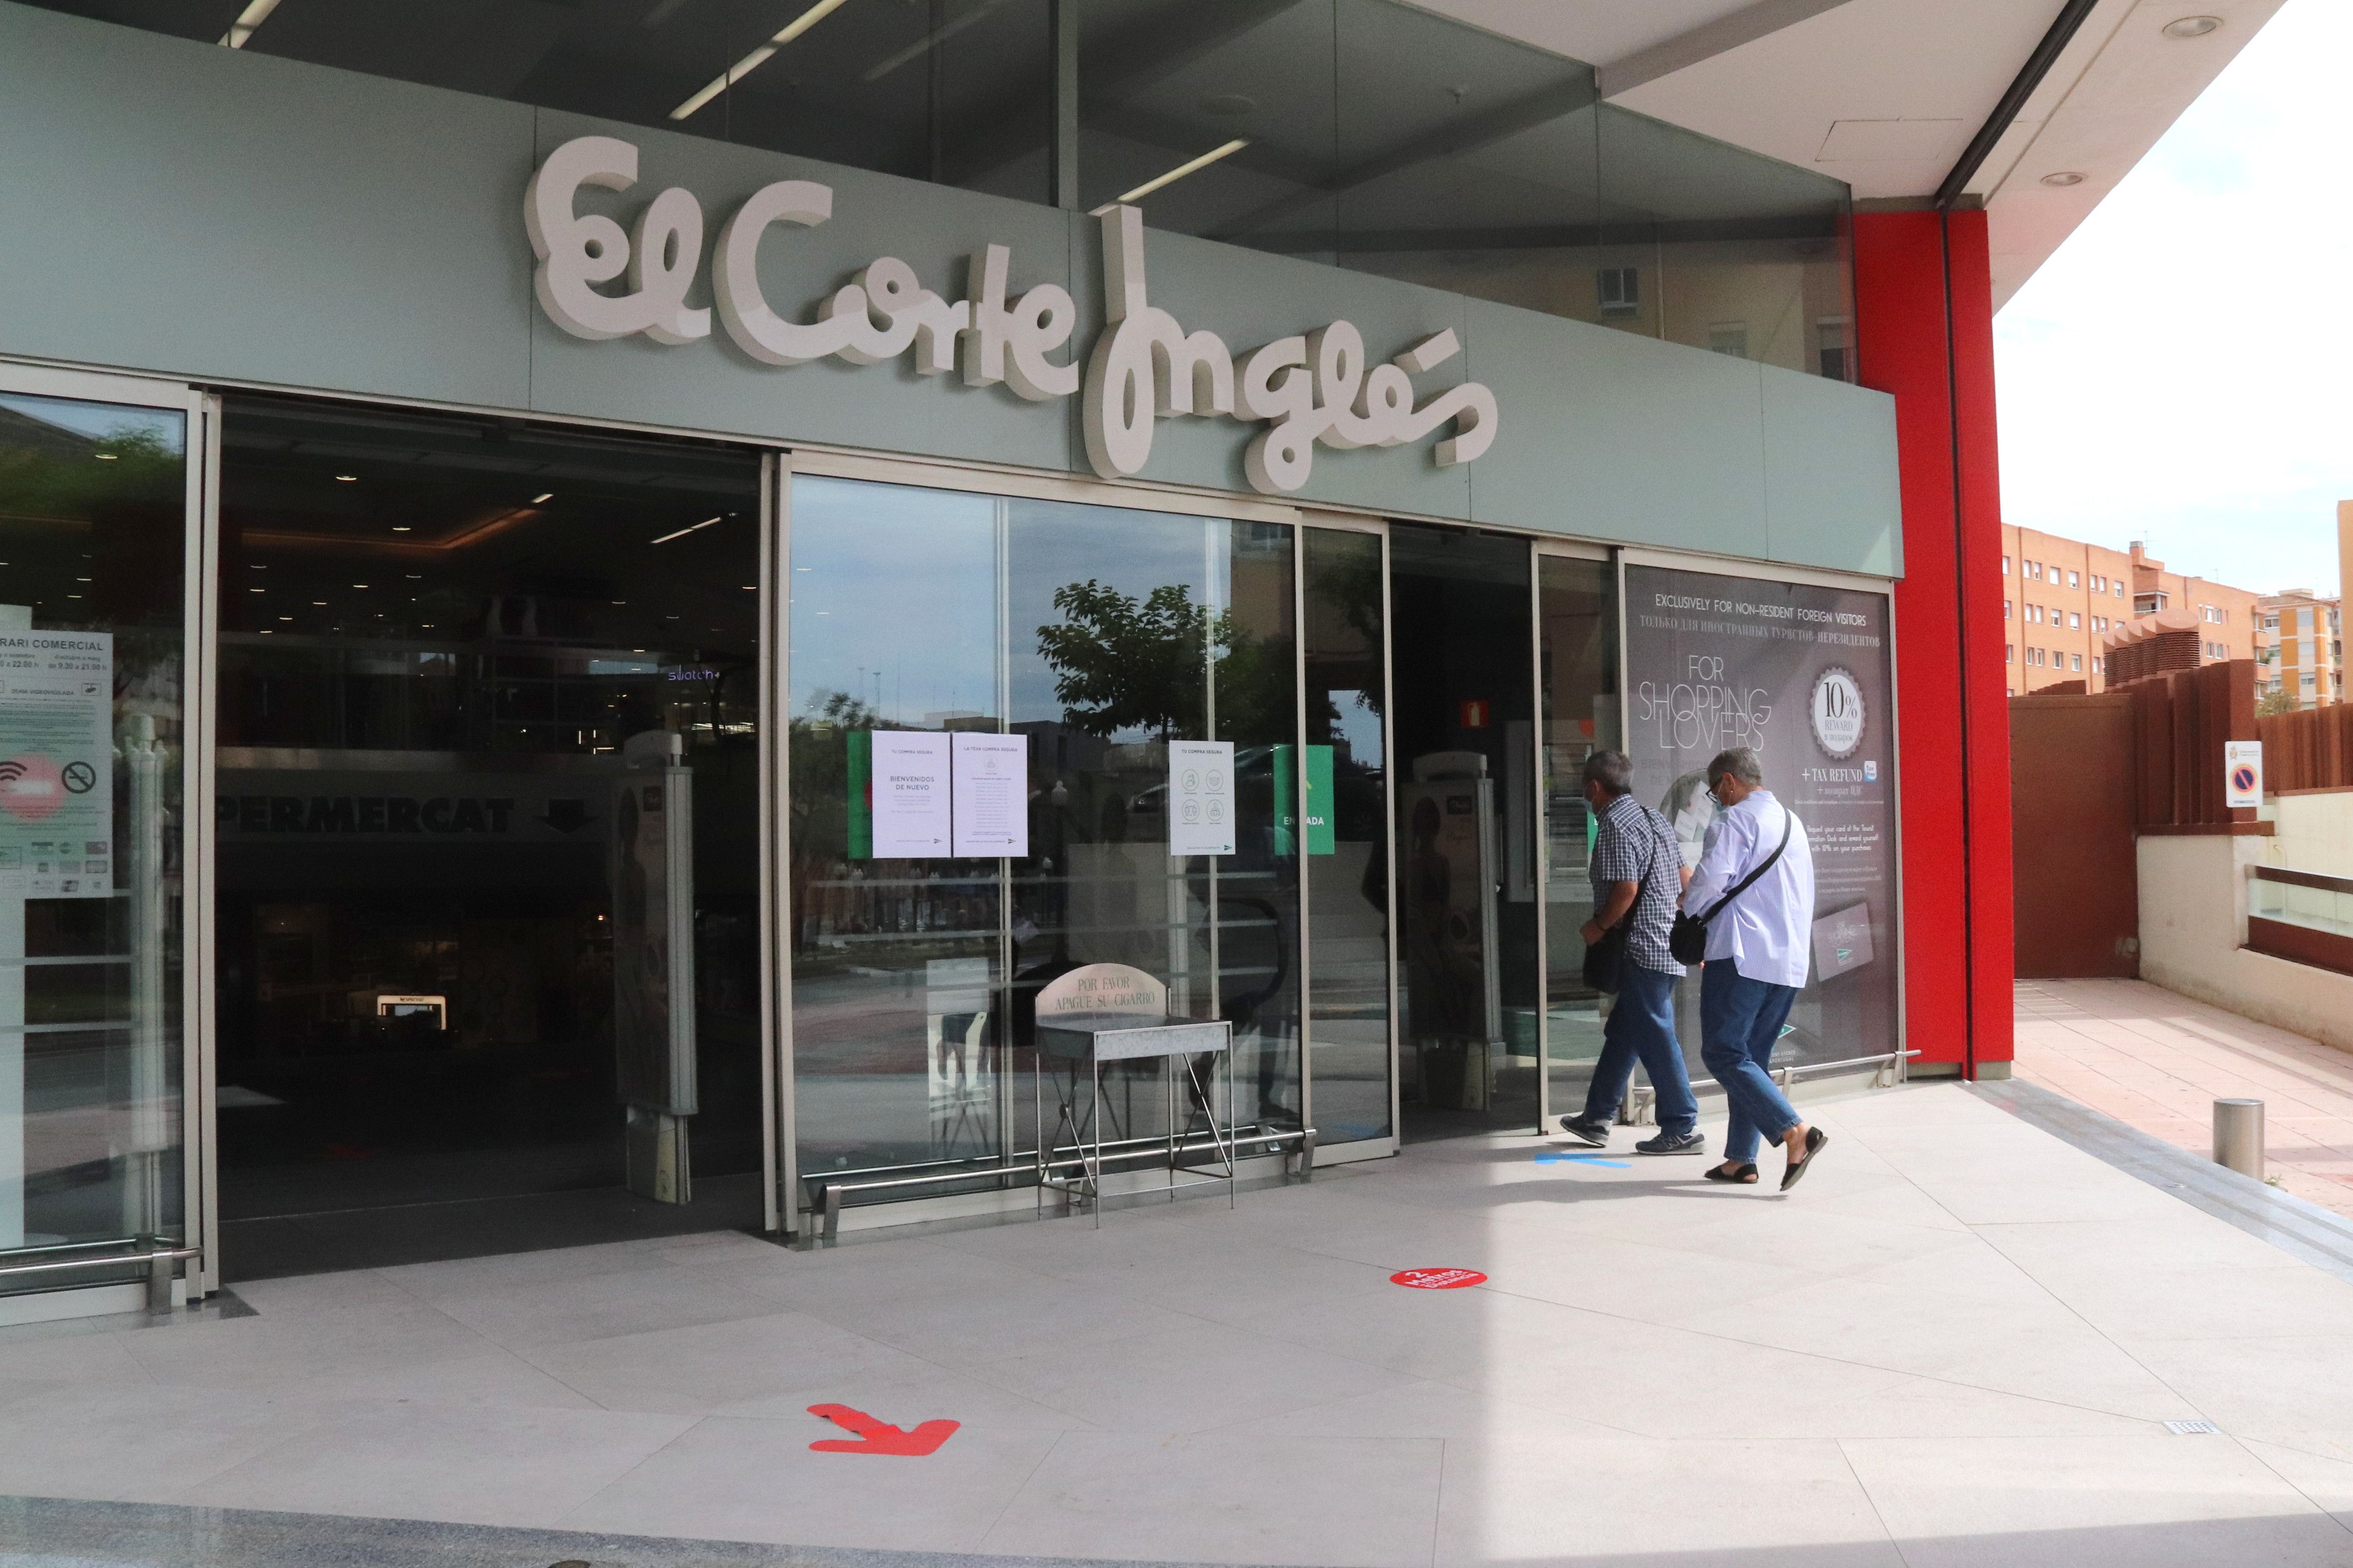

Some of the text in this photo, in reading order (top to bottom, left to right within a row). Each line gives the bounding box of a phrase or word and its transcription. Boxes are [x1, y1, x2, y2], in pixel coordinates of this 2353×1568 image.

[524, 136, 1498, 495] El Corte Inglés
[1656, 594, 1867, 627] EXCLUSIVELY FOR NON-RESIDENT FOREIGN VISITORS
[32, 639, 104, 650] COMERCIAL
[1689, 655, 1723, 681] FOR
[1639, 681, 1771, 725] SHOPPING
[1823, 682, 1857, 718] 10%
[1659, 709, 1764, 751] LOVERS
[1825, 719, 1853, 731] REWARD
[1812, 768, 1828, 782] TAX
[1830, 768, 1863, 782] REFUND
[1283, 816, 1324, 826] ENADA
[1078, 976, 1130, 991] POR FAVOR
[1055, 992, 1155, 1011] APAGUE SU CIGARRO
